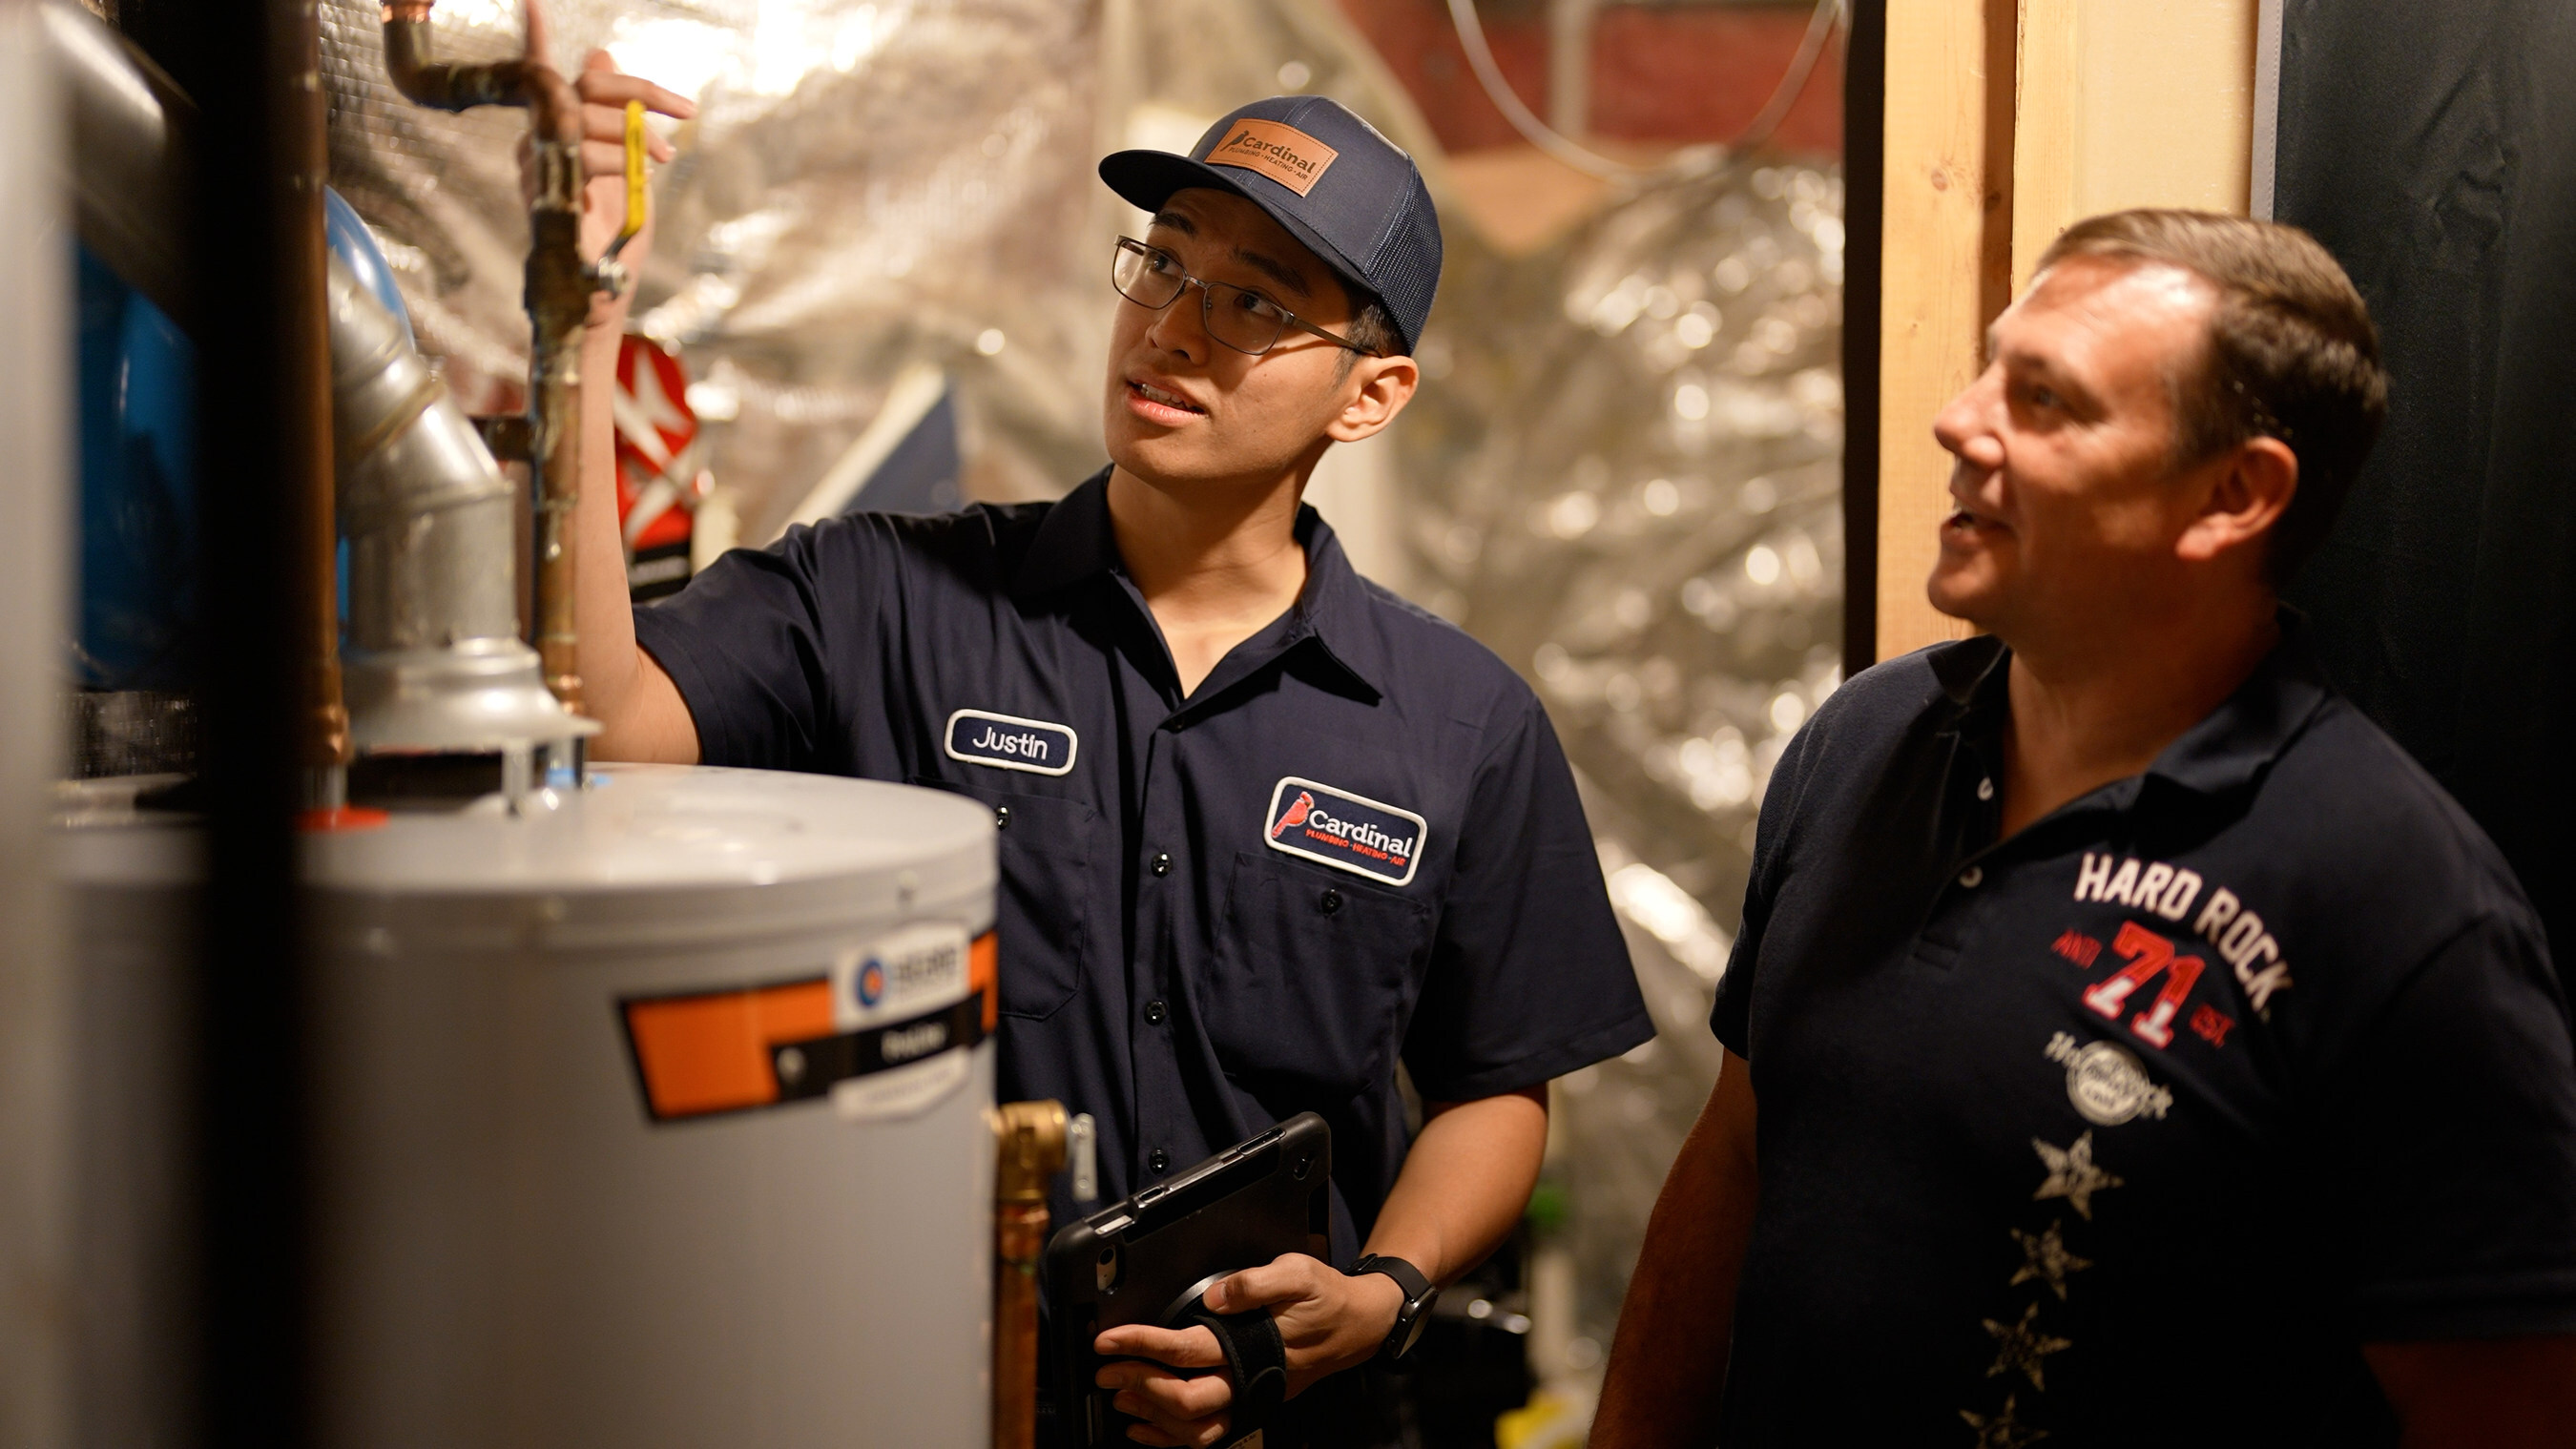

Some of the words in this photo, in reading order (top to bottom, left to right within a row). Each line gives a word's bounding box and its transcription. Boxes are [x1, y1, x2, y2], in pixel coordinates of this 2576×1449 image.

[1228, 147, 1260, 157] PLUMBING
[1263, 155, 1293, 172] HEATING
[1296, 171, 1308, 181] AIR
[1242, 136, 1316, 174] Cardinal
[972, 726, 1048, 760] Justin
[1308, 810, 1413, 858] Cardinal
[2074, 852, 2203, 921] HARD
[2193, 886, 2293, 1012] ROCK
[2082, 920, 2206, 1049] 71
